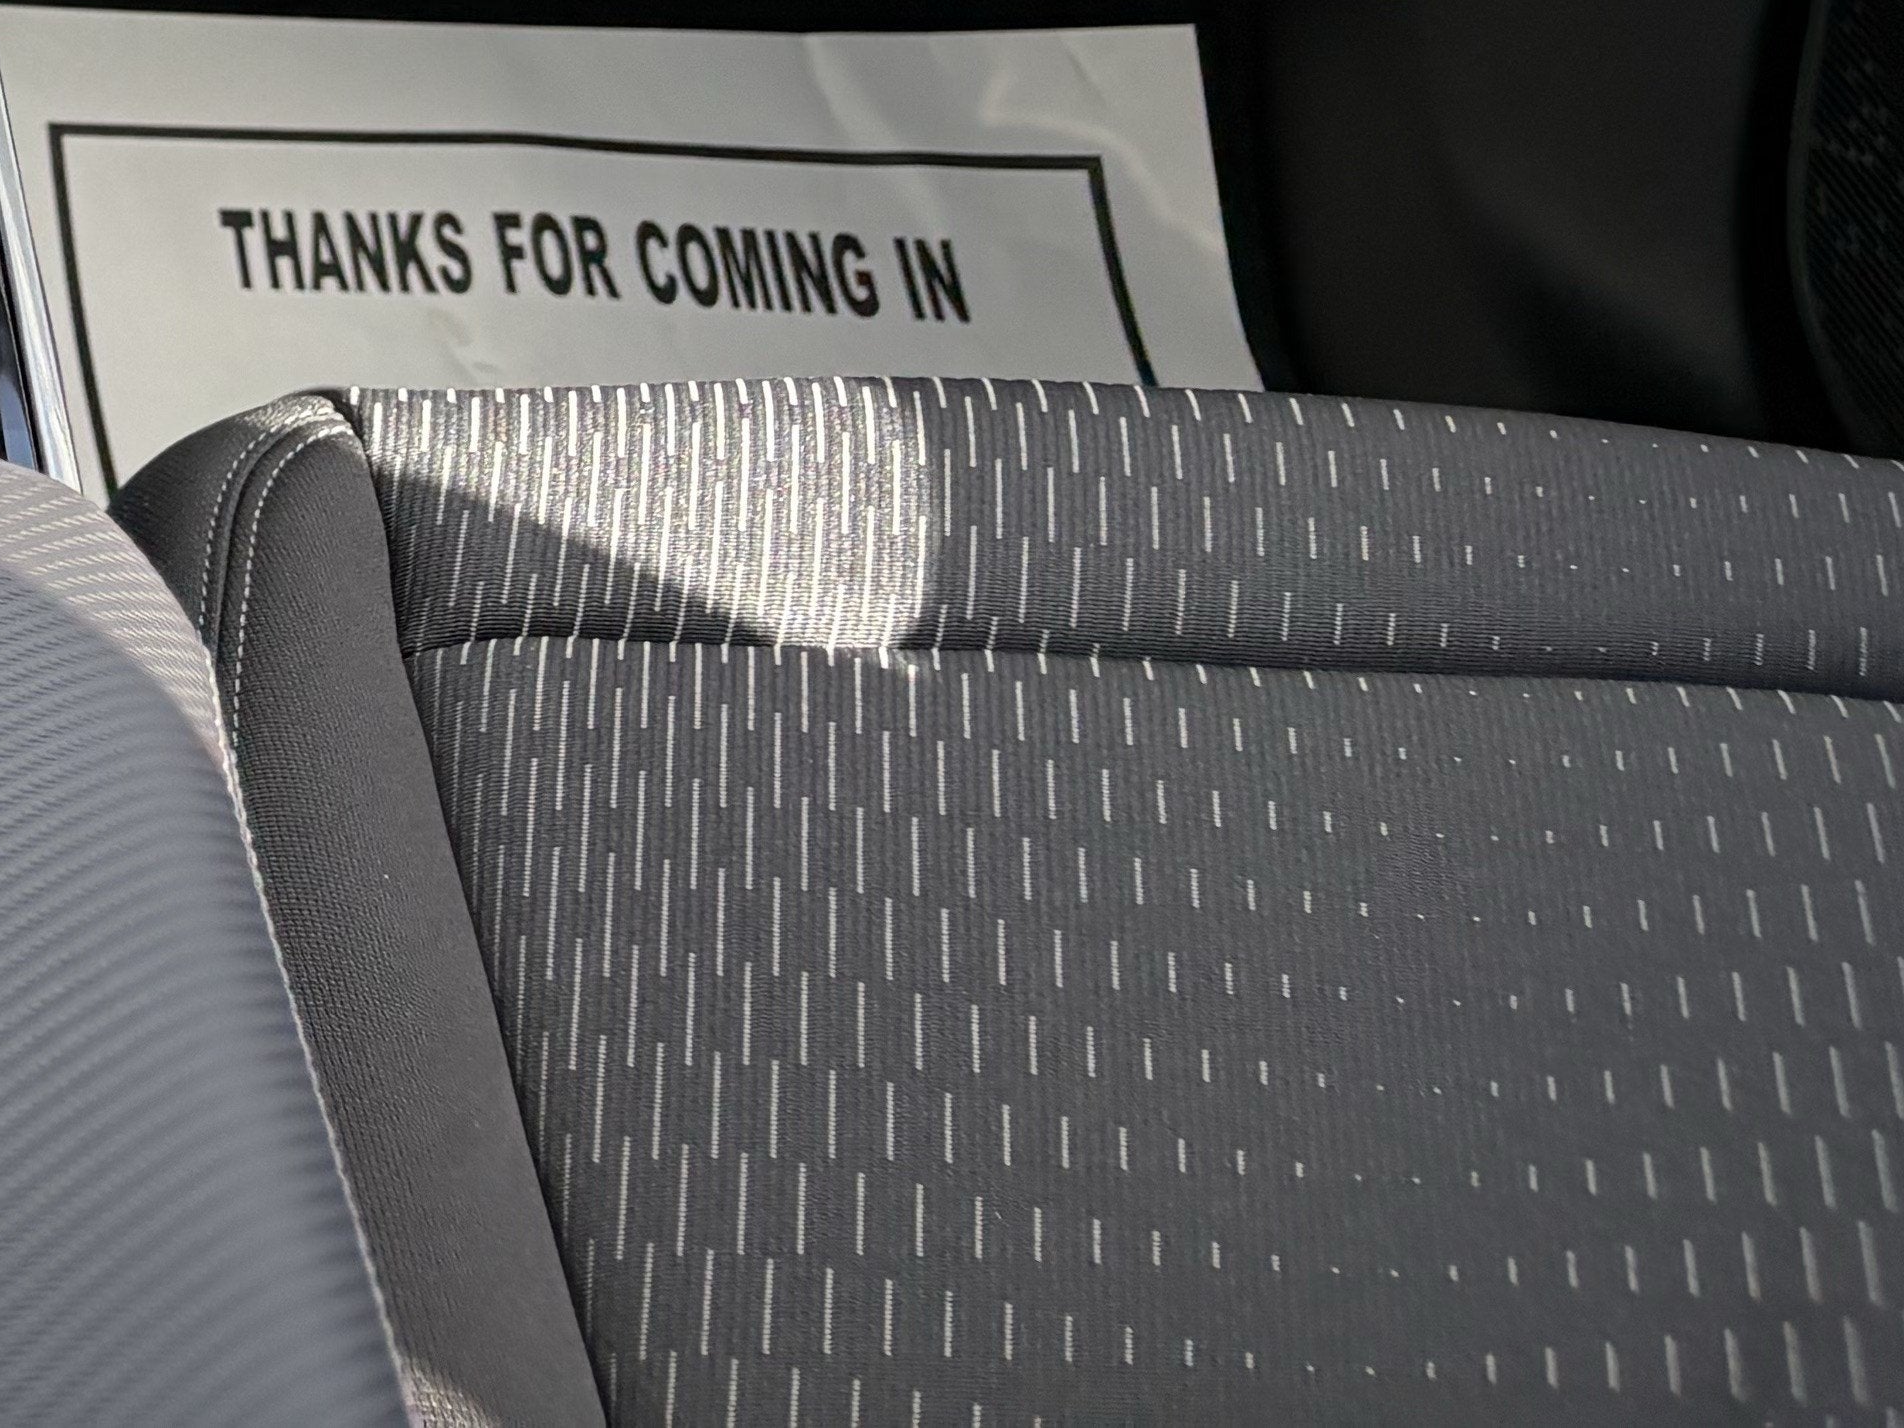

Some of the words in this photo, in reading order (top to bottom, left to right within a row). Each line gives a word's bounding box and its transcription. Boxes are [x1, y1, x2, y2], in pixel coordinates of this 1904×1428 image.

[218, 208, 473, 295] THANKS
[491, 211, 621, 300] FOR
[635, 218, 881, 320] COMING
[893, 236, 971, 325] IN
